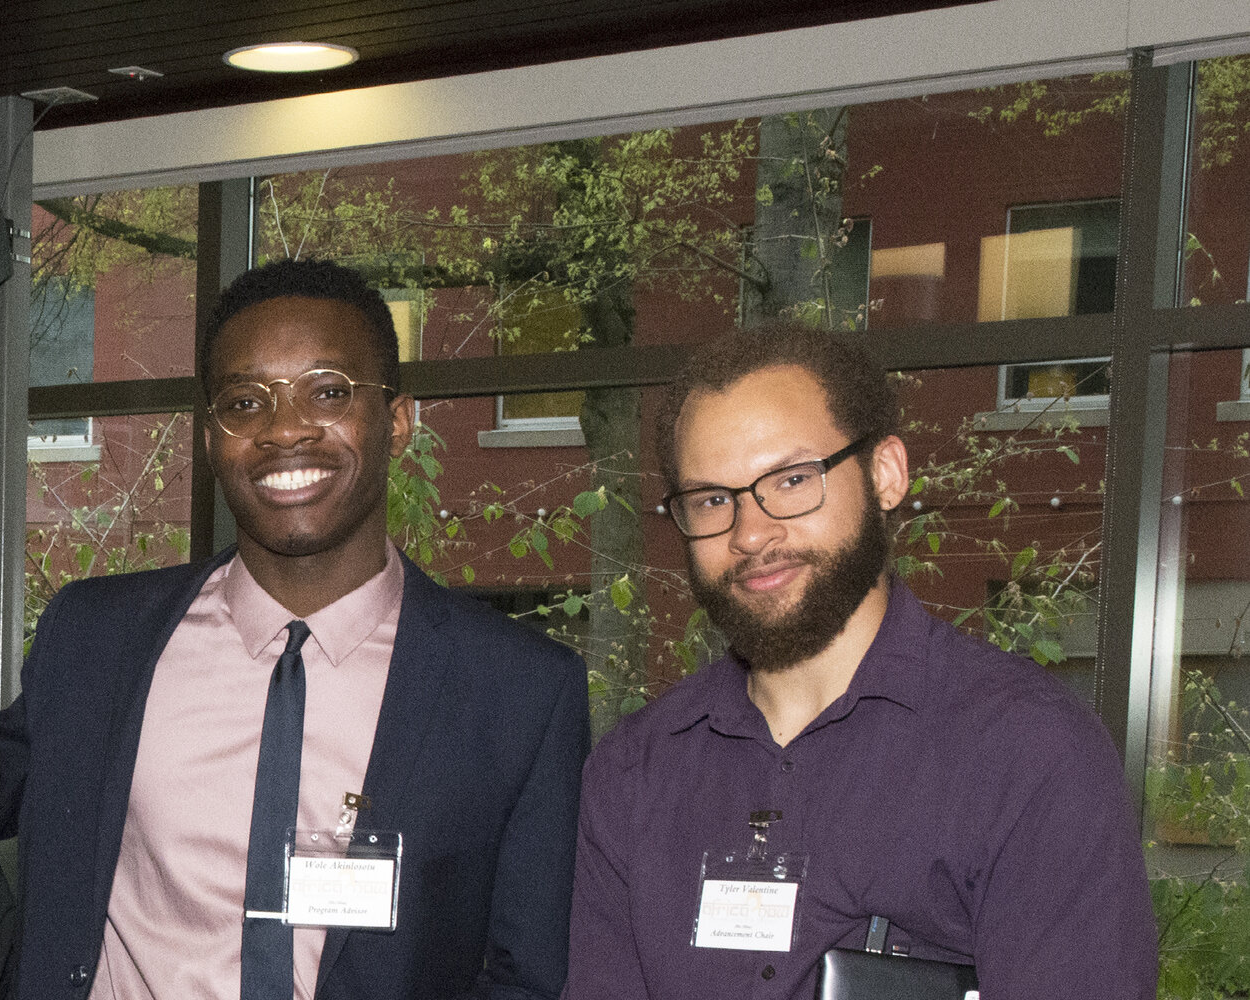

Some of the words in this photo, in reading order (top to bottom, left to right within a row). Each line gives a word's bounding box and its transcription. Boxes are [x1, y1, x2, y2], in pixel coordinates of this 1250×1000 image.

[719, 884, 740, 895] Tyler
[743, 884, 779, 895] Valentine
[308, 906, 338, 916] Program
[710, 929, 753, 938] Advancement
[755, 931, 775, 939] Chair
